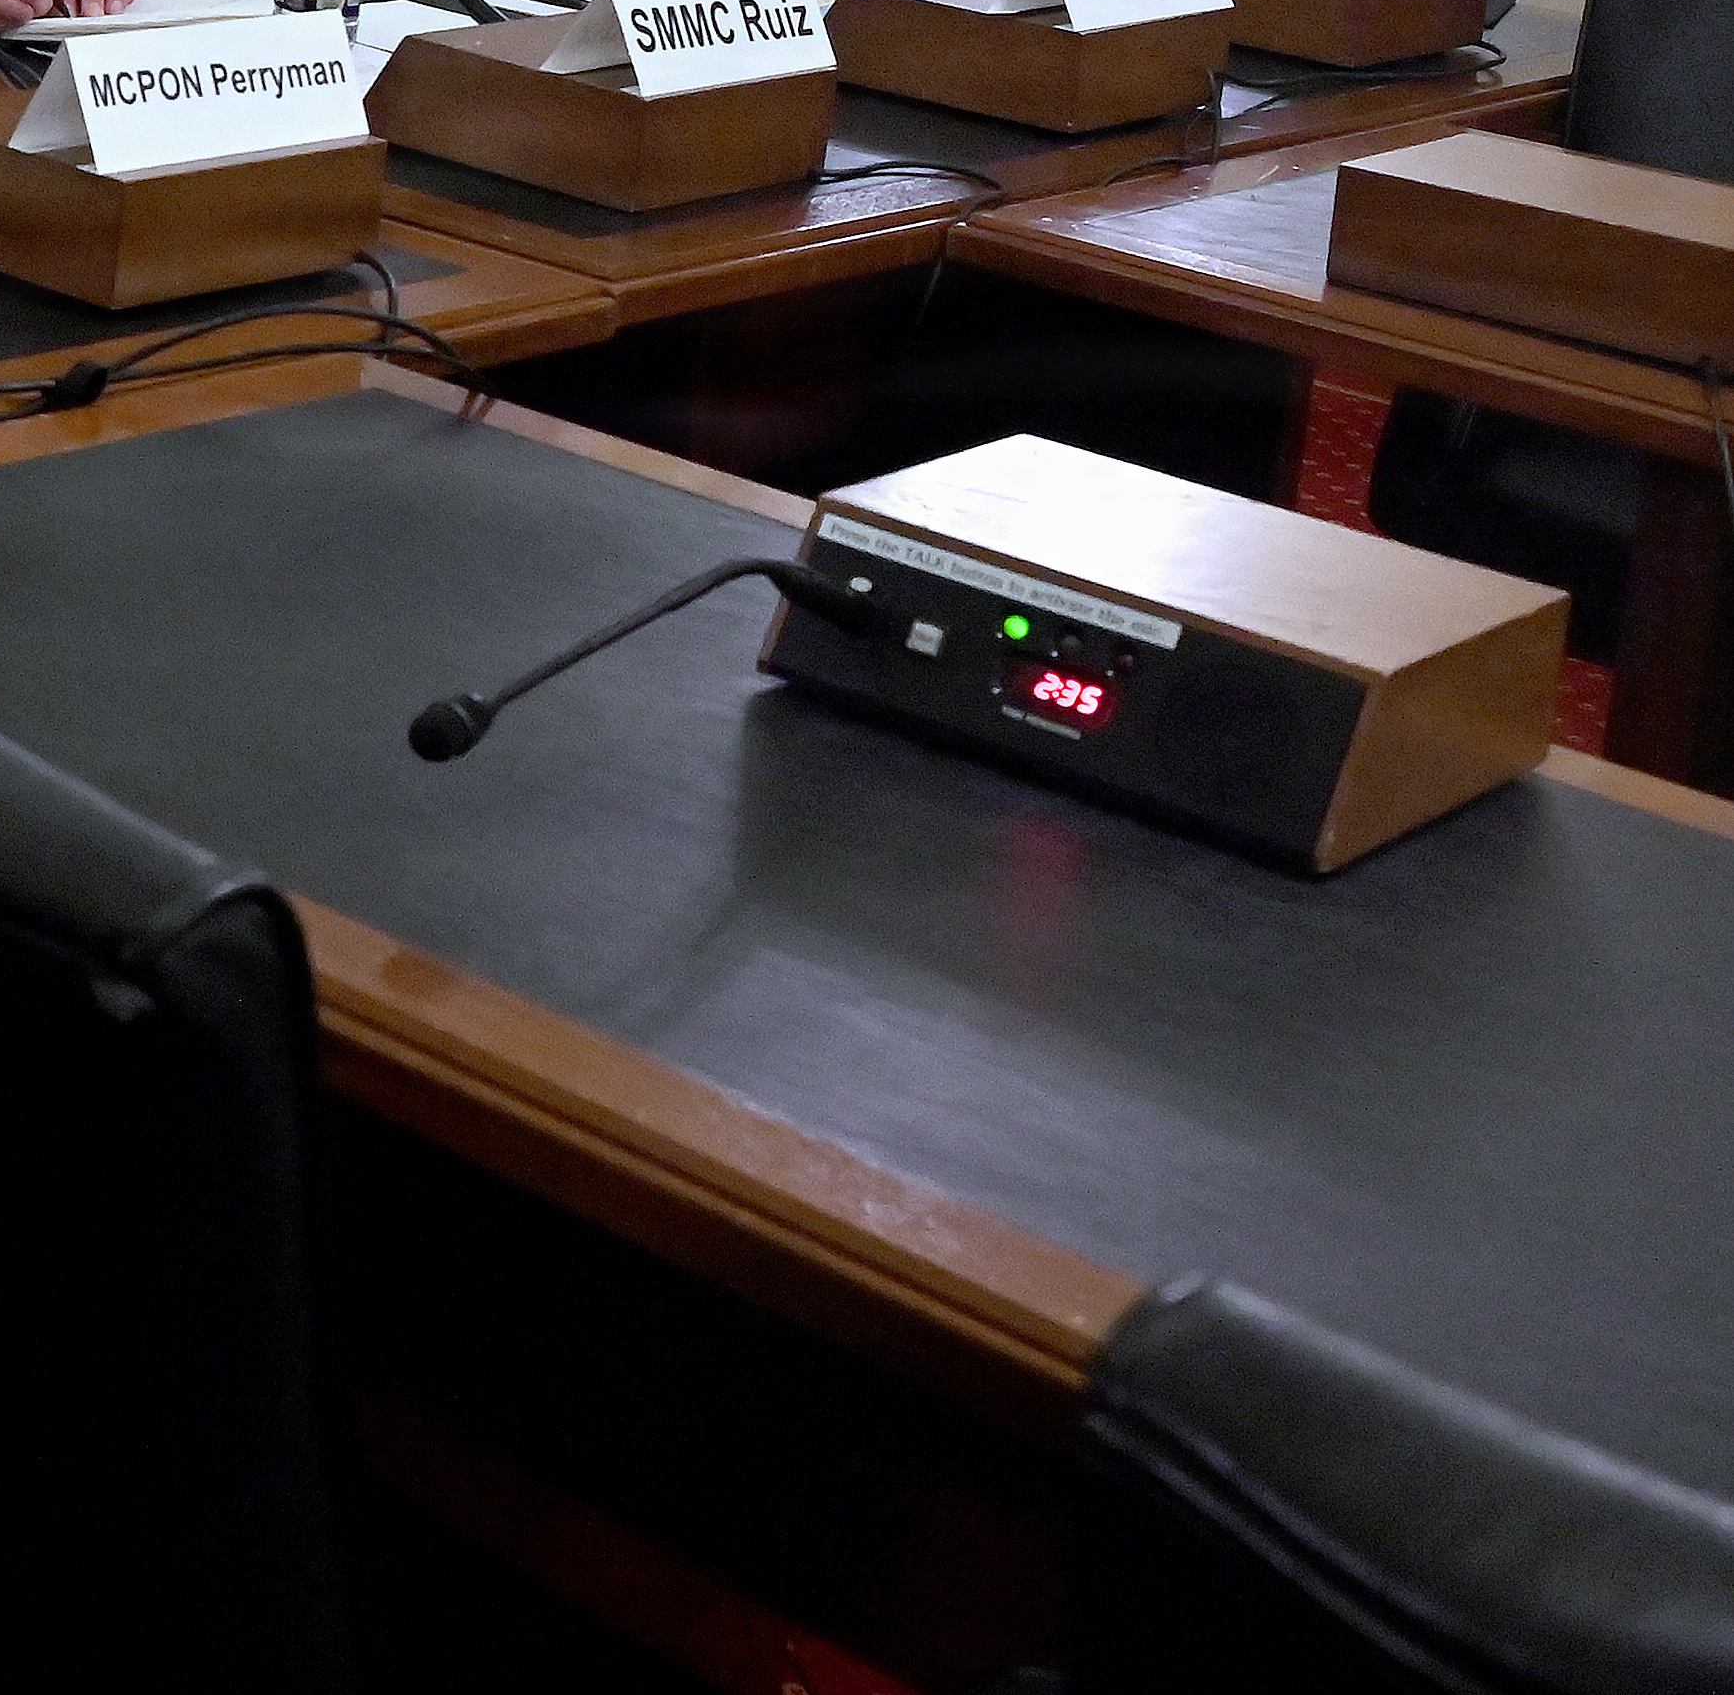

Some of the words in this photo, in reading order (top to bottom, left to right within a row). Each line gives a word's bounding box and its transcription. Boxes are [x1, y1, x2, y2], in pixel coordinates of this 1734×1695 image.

[631, 0, 735, 53] SMMC
[89, 64, 204, 109] MCPON
[209, 59, 347, 100] Perryman
[1032, 670, 1104, 716] 2:35
